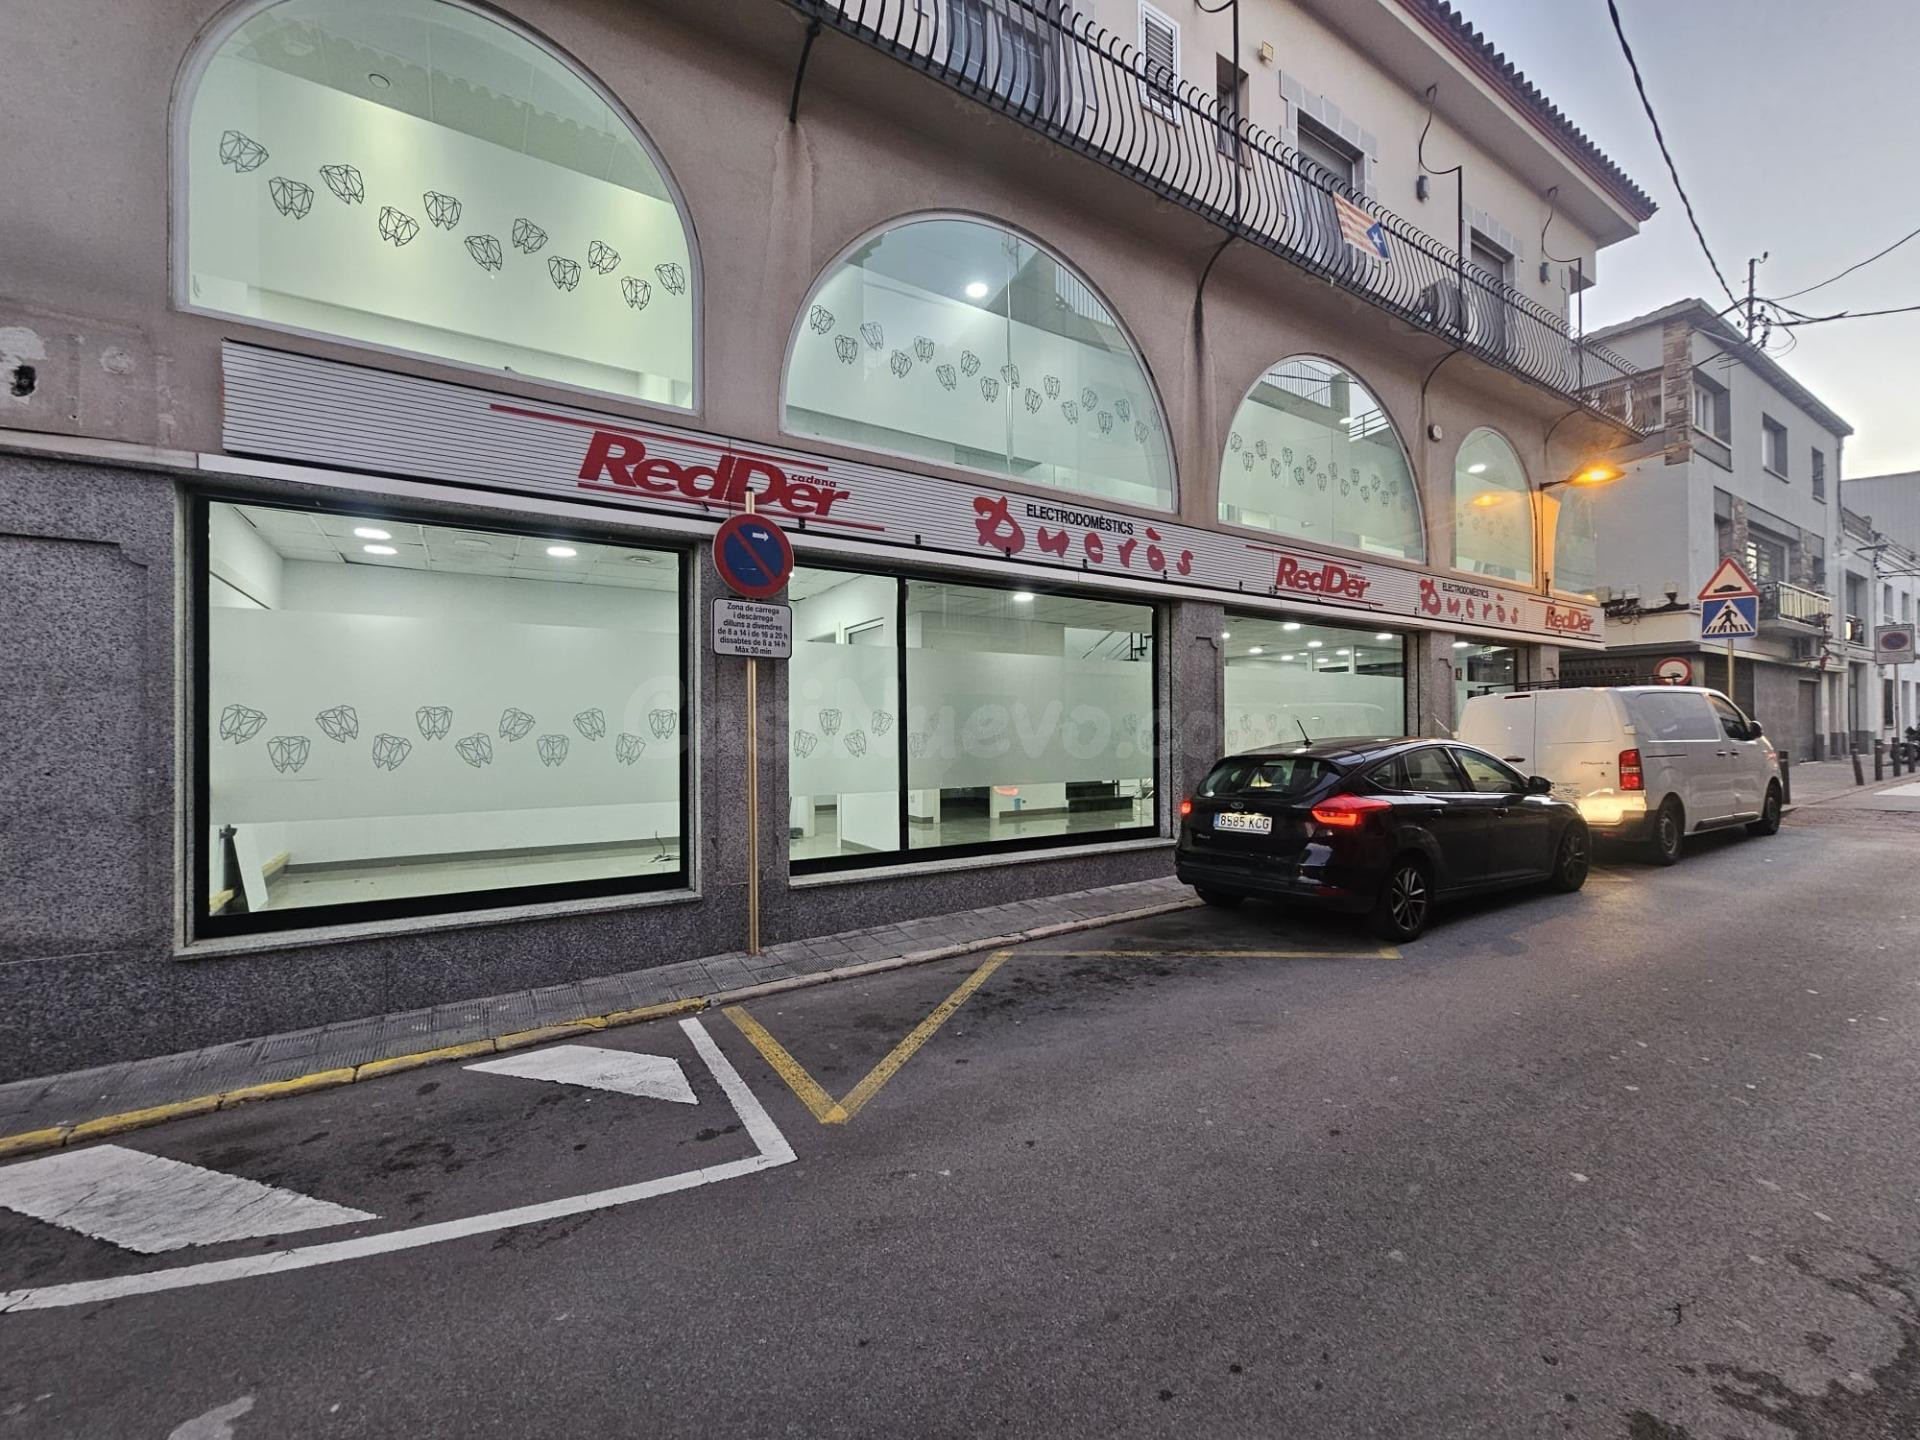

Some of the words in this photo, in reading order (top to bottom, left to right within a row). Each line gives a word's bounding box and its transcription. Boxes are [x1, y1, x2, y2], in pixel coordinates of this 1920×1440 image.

[578, 431, 850, 516] RedDer
[791, 472, 838, 489] cadena
[1276, 556, 1371, 599] RedDer
[727, 602, 744, 610] Zona
[745, 604, 754, 612] de
[755, 606, 780, 615] càrrega
[737, 612, 774, 623] descàrrega
[1545, 605, 1594, 632] RedDer
[723, 619, 745, 628] dilluns
[752, 621, 783, 631] divendres
[717, 626, 727, 635] de
[751, 630, 760, 638] de
[774, 632, 783, 640] 20
[719, 636, 751, 646] dissabtes
[752, 638, 761, 646] de
[750, 646, 759, 654] 30
[759, 646, 772, 656] min
[1220, 815, 1245, 828] 8585
[1248, 817, 1270, 830] KCG
